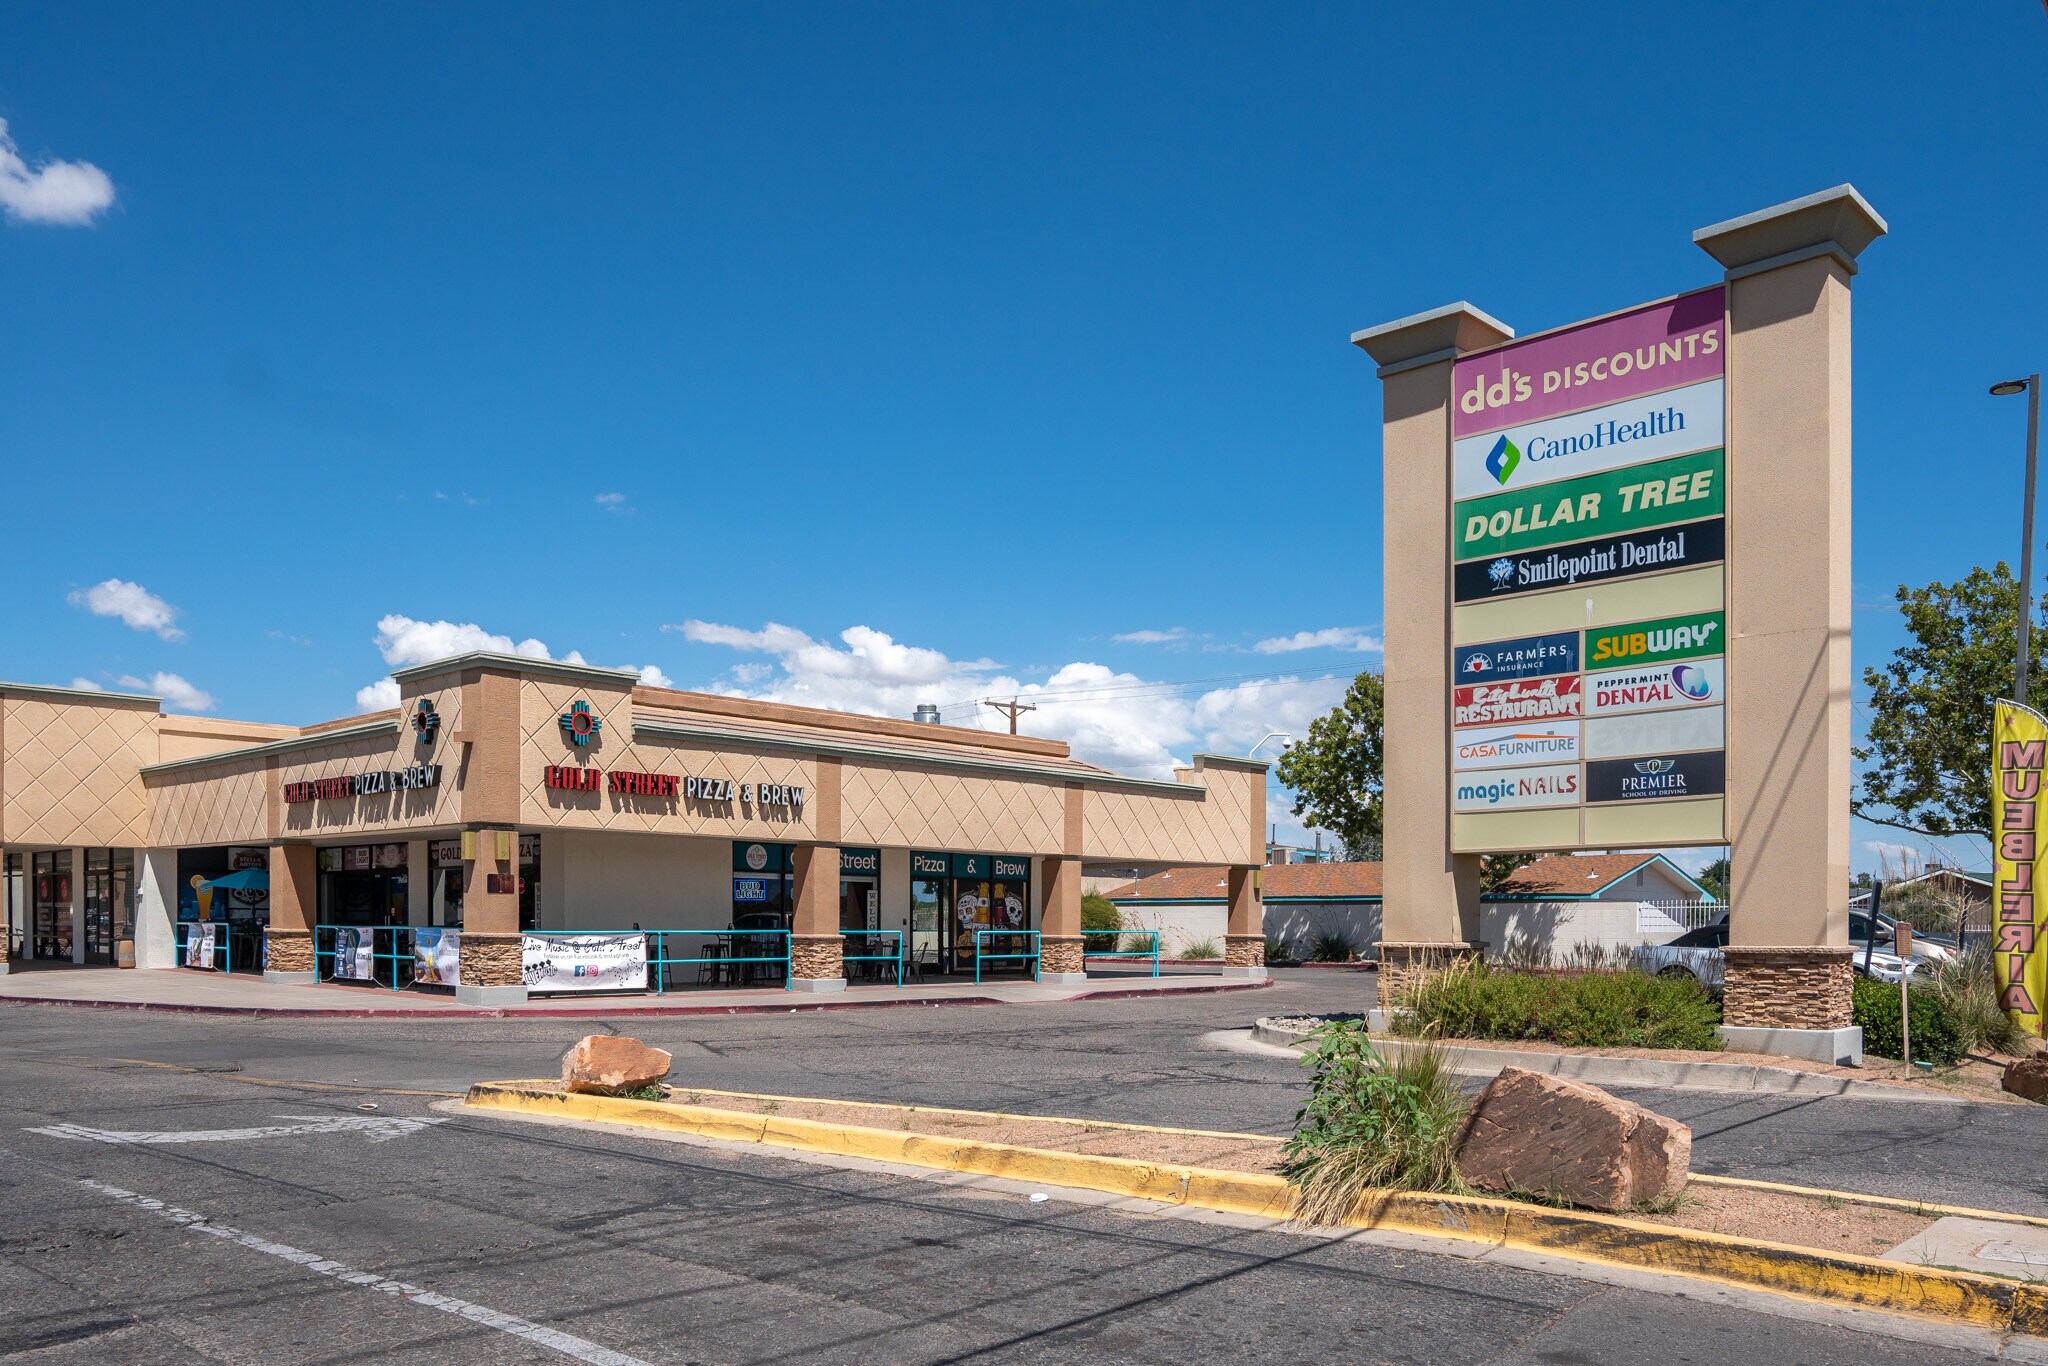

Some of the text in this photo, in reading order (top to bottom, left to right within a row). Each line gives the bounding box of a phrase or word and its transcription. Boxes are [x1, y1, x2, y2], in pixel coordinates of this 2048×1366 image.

[1461, 329, 1719, 414] dd's DISCOUNTS
[1527, 407, 1686, 462] CanoHealth
[1464, 469, 1714, 542] DOLLAR TREE
[1518, 532, 1686, 585] Smilepoint Dental
[1592, 621, 1718, 661] SUBWAY
[1497, 645, 1567, 663] FARMERS
[1497, 661, 1544, 672] INSURANCE
[1597, 673, 1669, 688] PEPPERMINT
[1596, 683, 1673, 707] DENTAL
[1455, 693, 1580, 724] RESTAURANT
[1460, 738, 1575, 759] CASA FURNITURE
[314, 776, 350, 800] STREET
[355, 771, 384, 796] PIZZA
[390, 772, 396, 791] &
[403, 765, 435, 789] BREW
[547, 765, 805, 806] GOLD STREET PIZZA & BREW
[1458, 775, 1577, 803] magic NAILS
[1622, 774, 1687, 790] PREMIER
[1659, 788, 1687, 796] DRIVING
[914, 856, 945, 872] Pizza
[967, 859, 976, 874] &
[996, 861, 1025, 875] Brew
[736, 890, 764, 899] LIGHT
[739, 882, 760, 891] BUD
[522, 936, 645, 953] Live Music @ Gold Street
